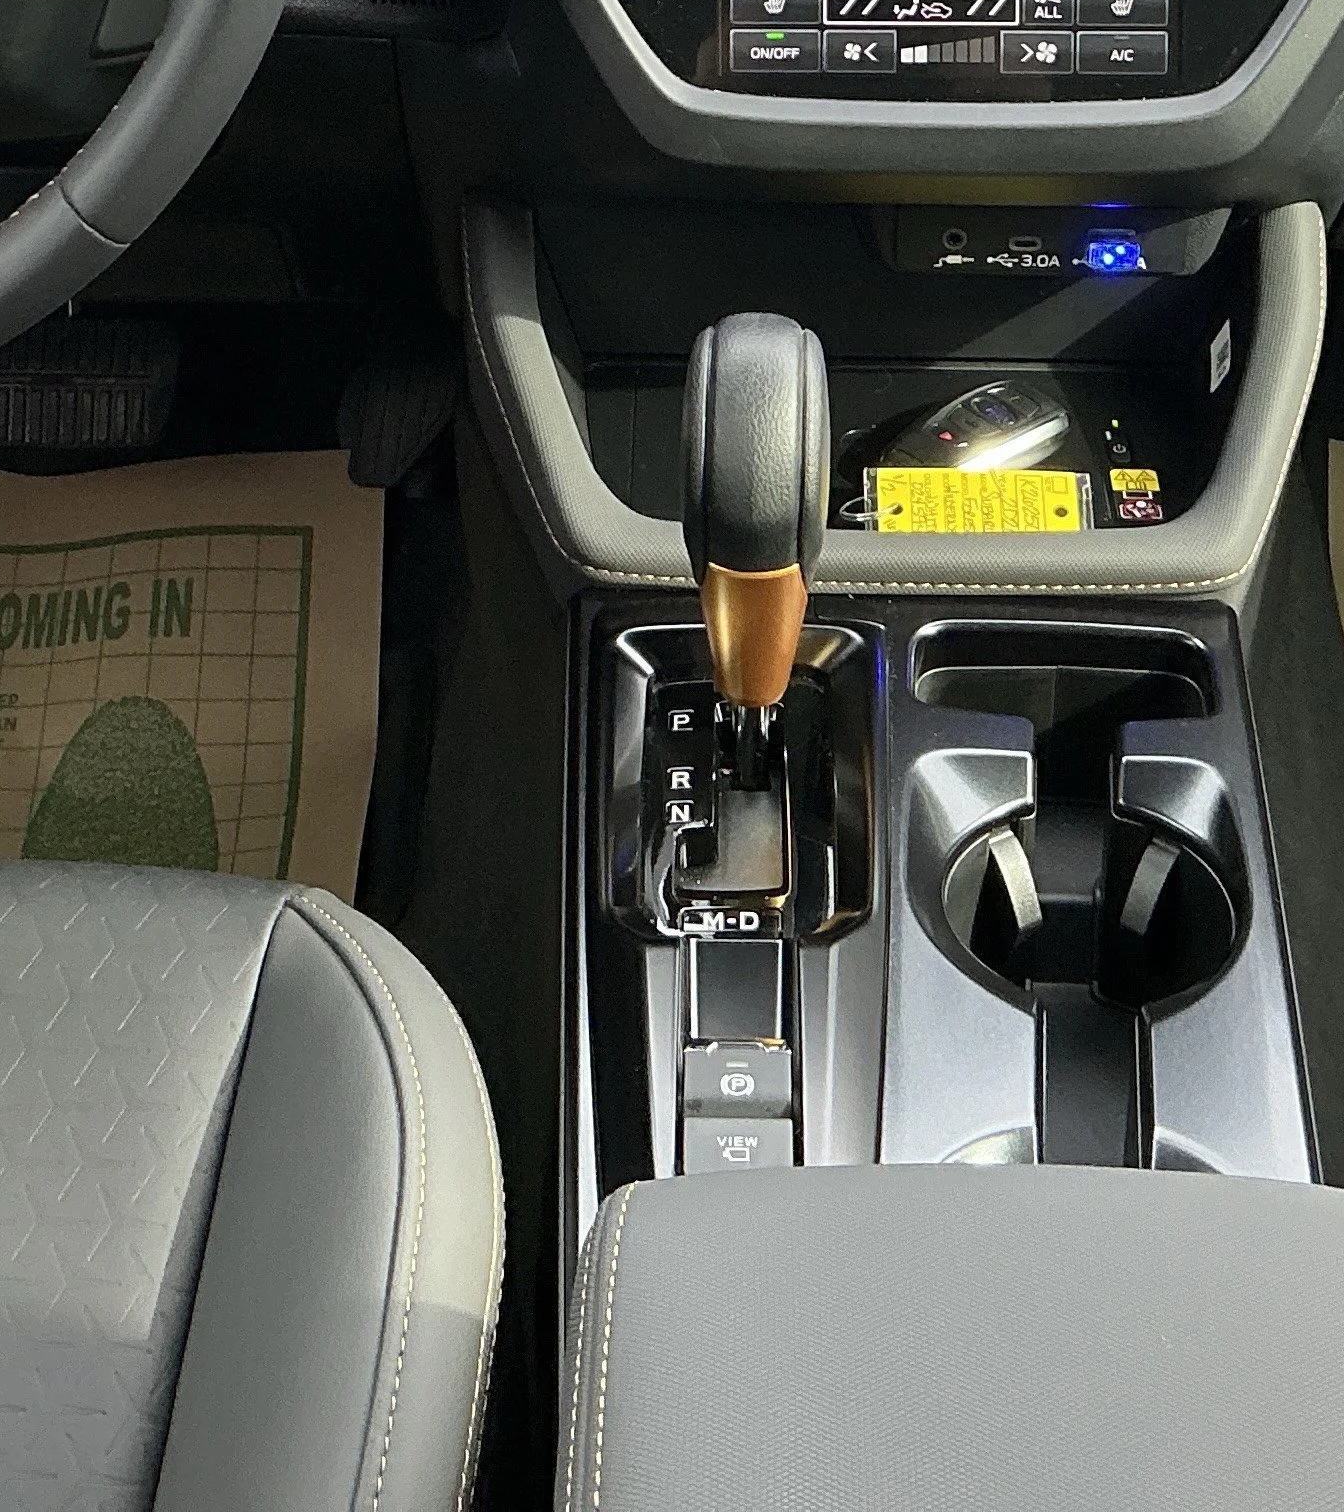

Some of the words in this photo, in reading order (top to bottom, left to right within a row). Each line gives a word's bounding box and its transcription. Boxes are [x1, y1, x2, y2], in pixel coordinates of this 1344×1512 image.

[1034, 5, 1063, 20] ALL
[750, 47, 800, 59] ON/OFF
[1109, 49, 1134, 63] A/C
[1021, 254, 1060, 268] 3.0A
[148, 577, 194, 640] IN
[672, 712, 691, 731] P
[671, 770, 691, 788] R
[671, 804, 690, 823] N
[717, 1135, 758, 1148] VIEW
